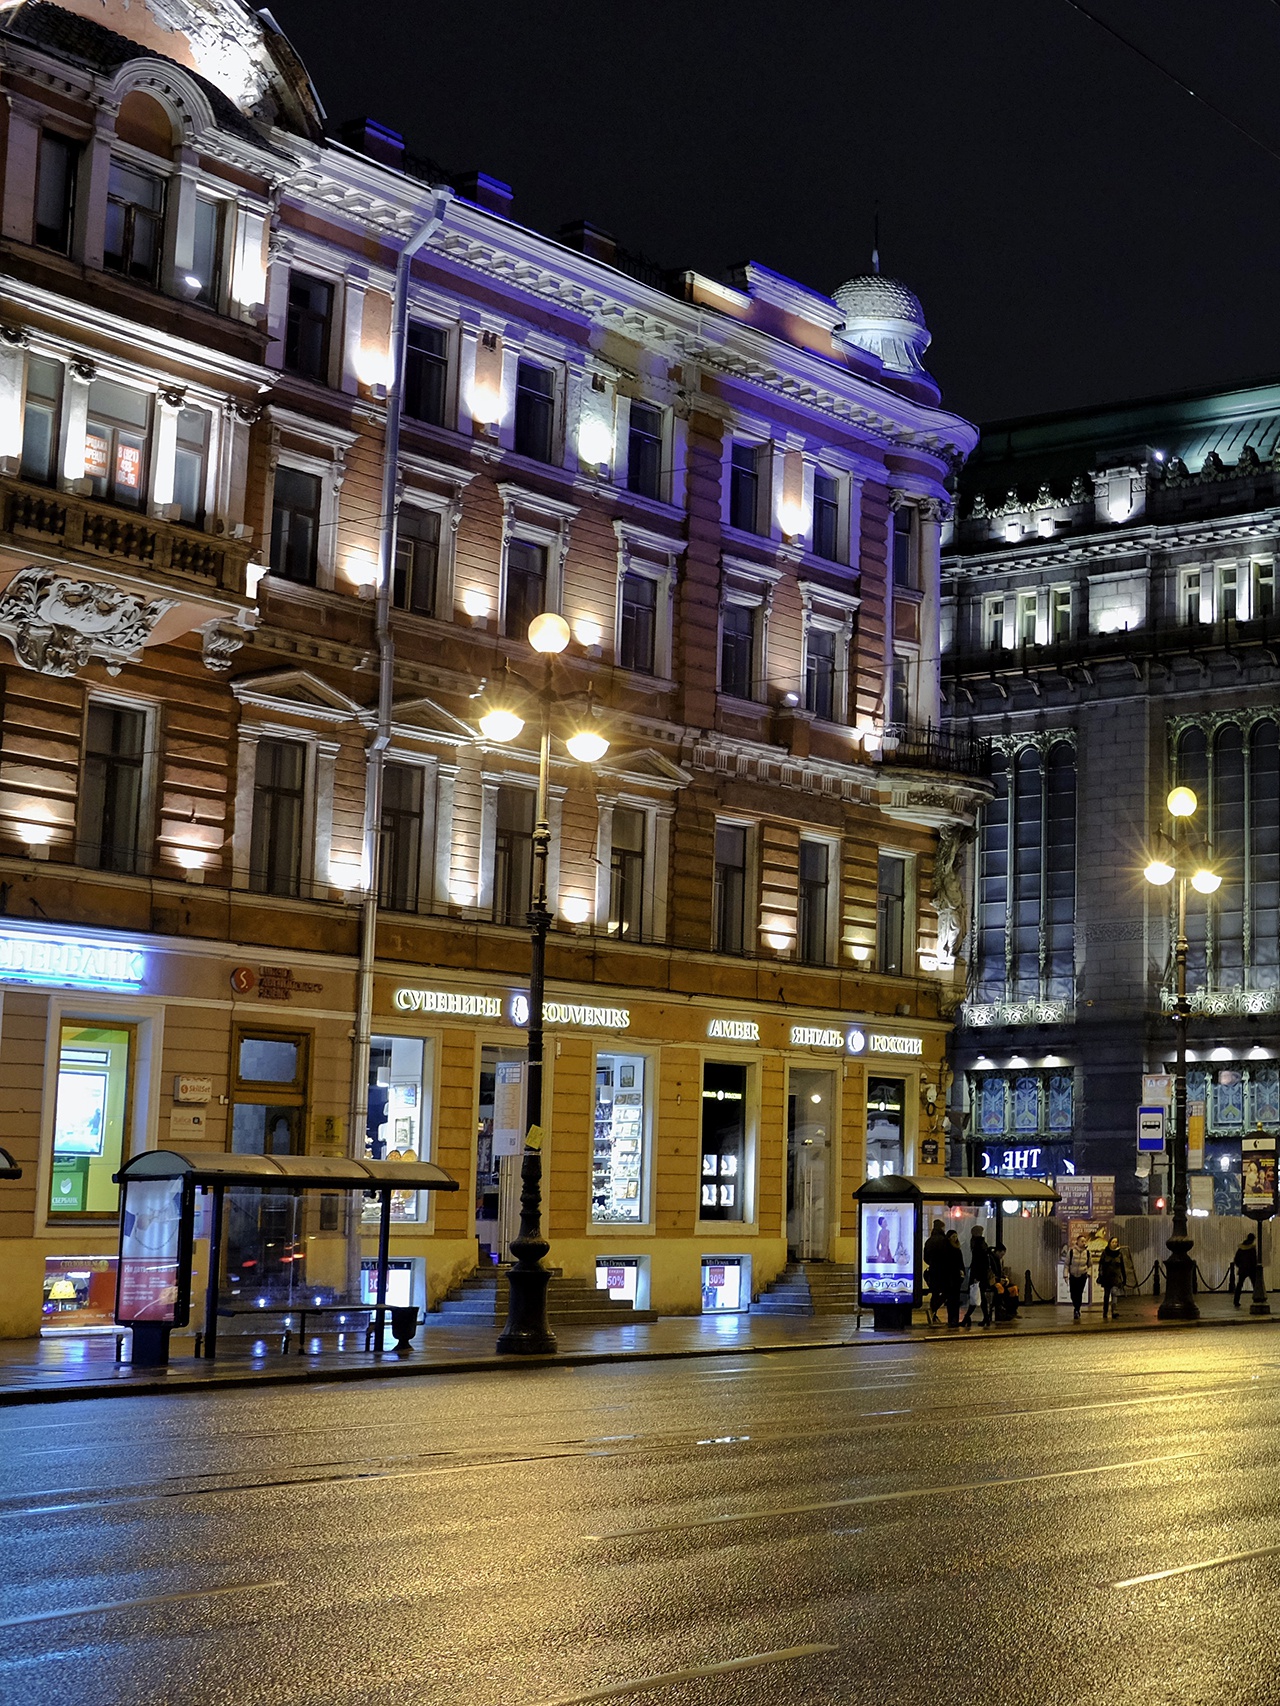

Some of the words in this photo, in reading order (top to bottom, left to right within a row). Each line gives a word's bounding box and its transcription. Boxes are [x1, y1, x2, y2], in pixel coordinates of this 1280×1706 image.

[397, 989, 502, 1017] СУВЕНИРЫ
[542, 1003, 630, 1028] SOUVENIRS
[709, 1019, 759, 1041] AMBER
[792, 1027, 844, 1048] ЯНТАРЬ
[870, 1035, 923, 1055] РОССИИ
[607, 1275, 624, 1287] 50%
[709, 1274, 725, 1285] 30%
